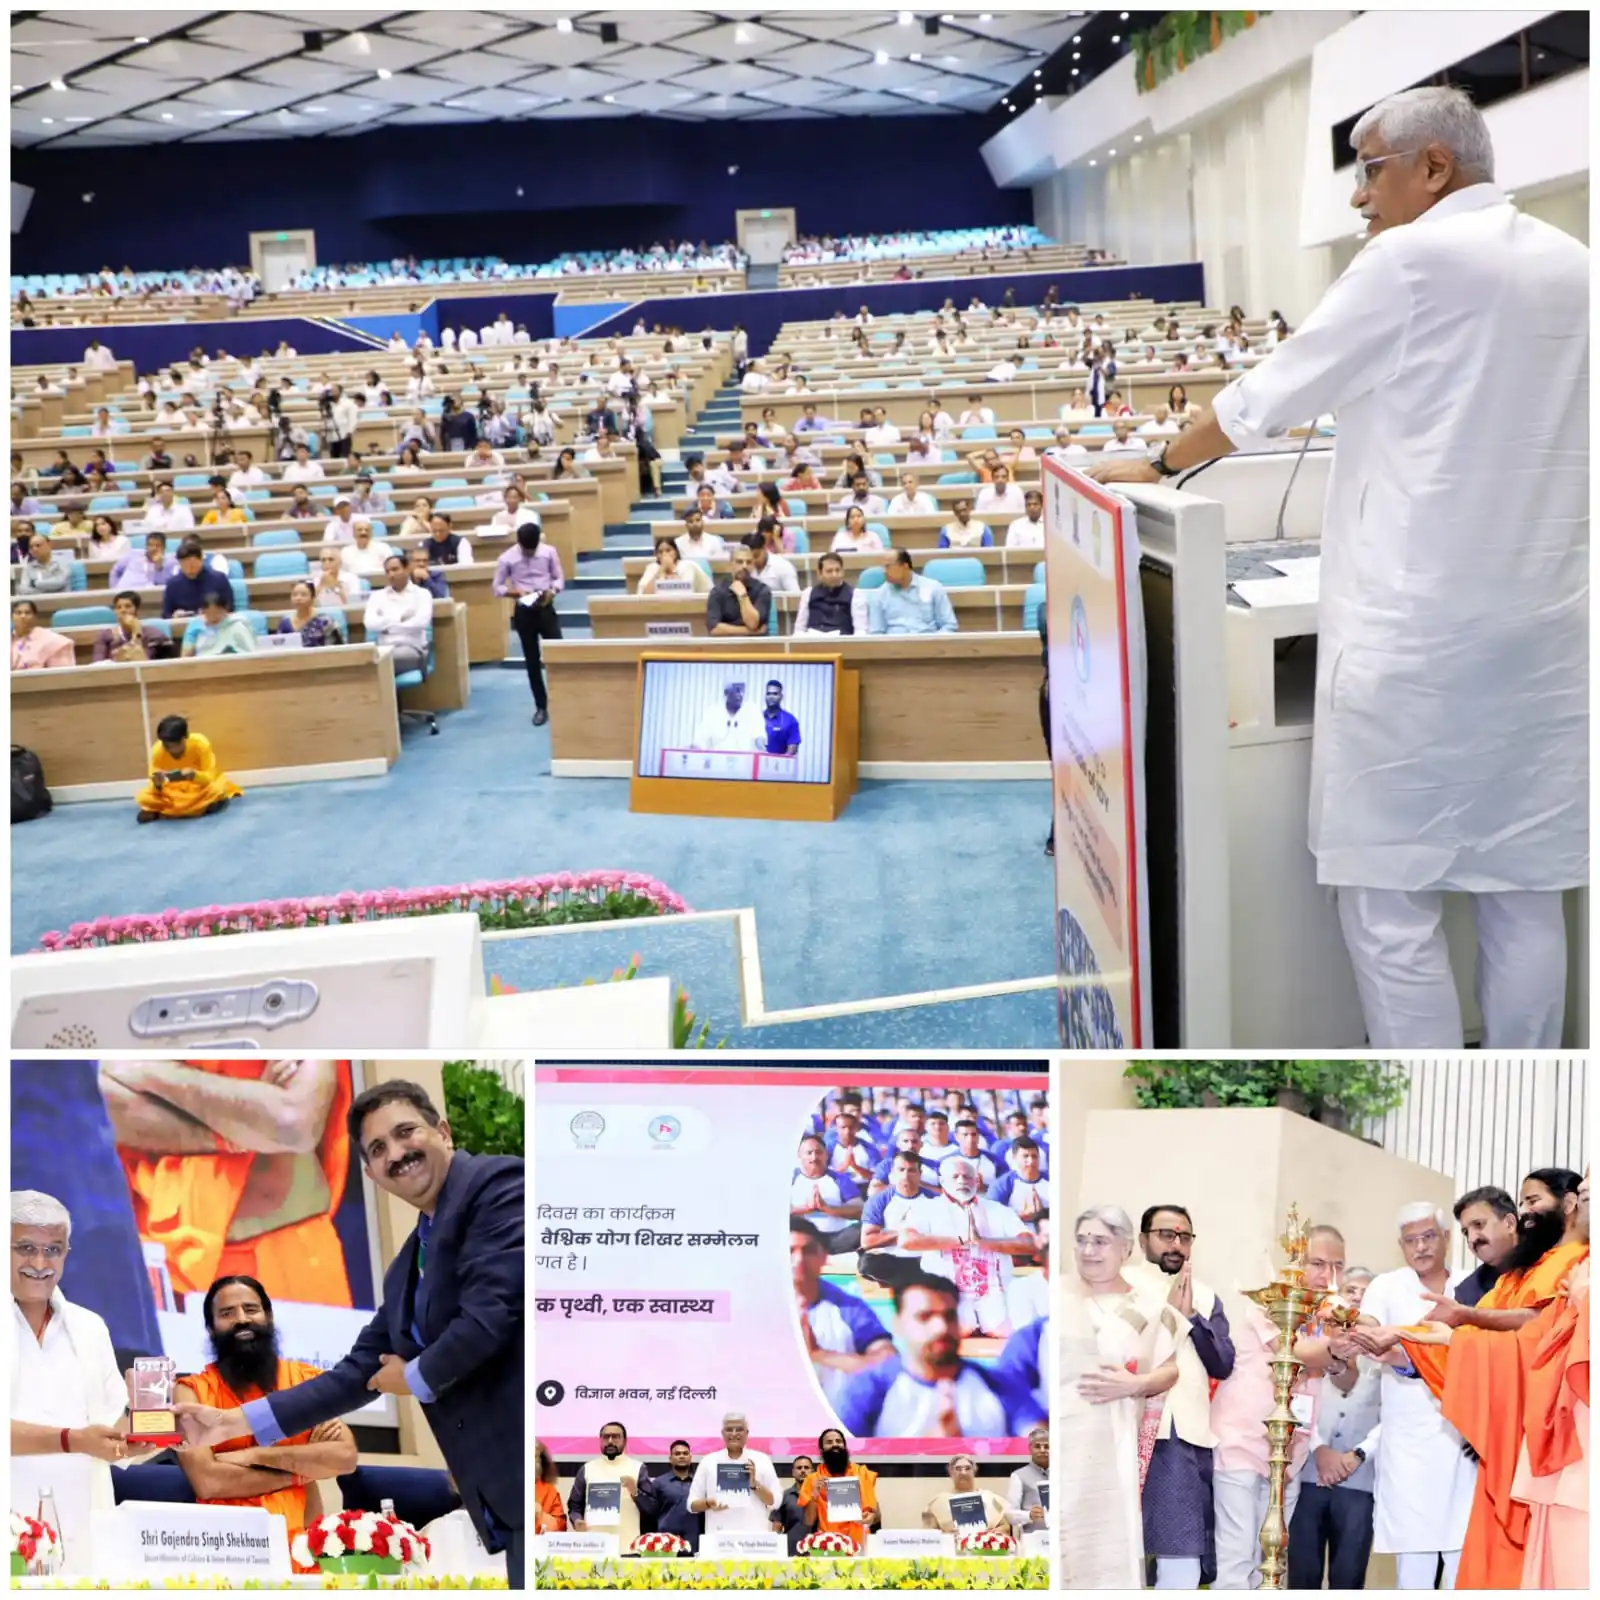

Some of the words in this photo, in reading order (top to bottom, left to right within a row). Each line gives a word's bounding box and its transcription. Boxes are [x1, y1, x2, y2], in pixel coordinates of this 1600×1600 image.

[648, 626, 690, 635] RESERVED
[536, 1203, 578, 1221] दिवस
[582, 1206, 605, 1221] का
[609, 1203, 676, 1221] कार्यक्रम
[540, 1226, 593, 1247] वैश्विक
[596, 1228, 630, 1247] योग
[634, 1228, 684, 1247] शिखर
[686, 1229, 760, 1248] सम्मेलन
[535, 1254, 563, 1270] गत
[535, 1298, 556, 1313] क
[559, 1293, 608, 1319] पृथ्वी,
[612, 1298, 645, 1313] एक
[649, 1298, 715, 1314] स्वास्थ्य
[575, 1385, 616, 1400] विज्ञान
[619, 1387, 653, 1402] भवन,
[656, 1385, 678, 1400] नई
[679, 1385, 718, 1400] दिल्ली
[141, 1530, 158, 1546] Shri
[160, 1529, 200, 1550] Gajendra
[201, 1531, 225, 1551] Singh
[226, 1532, 270, 1549] Shekhawat
